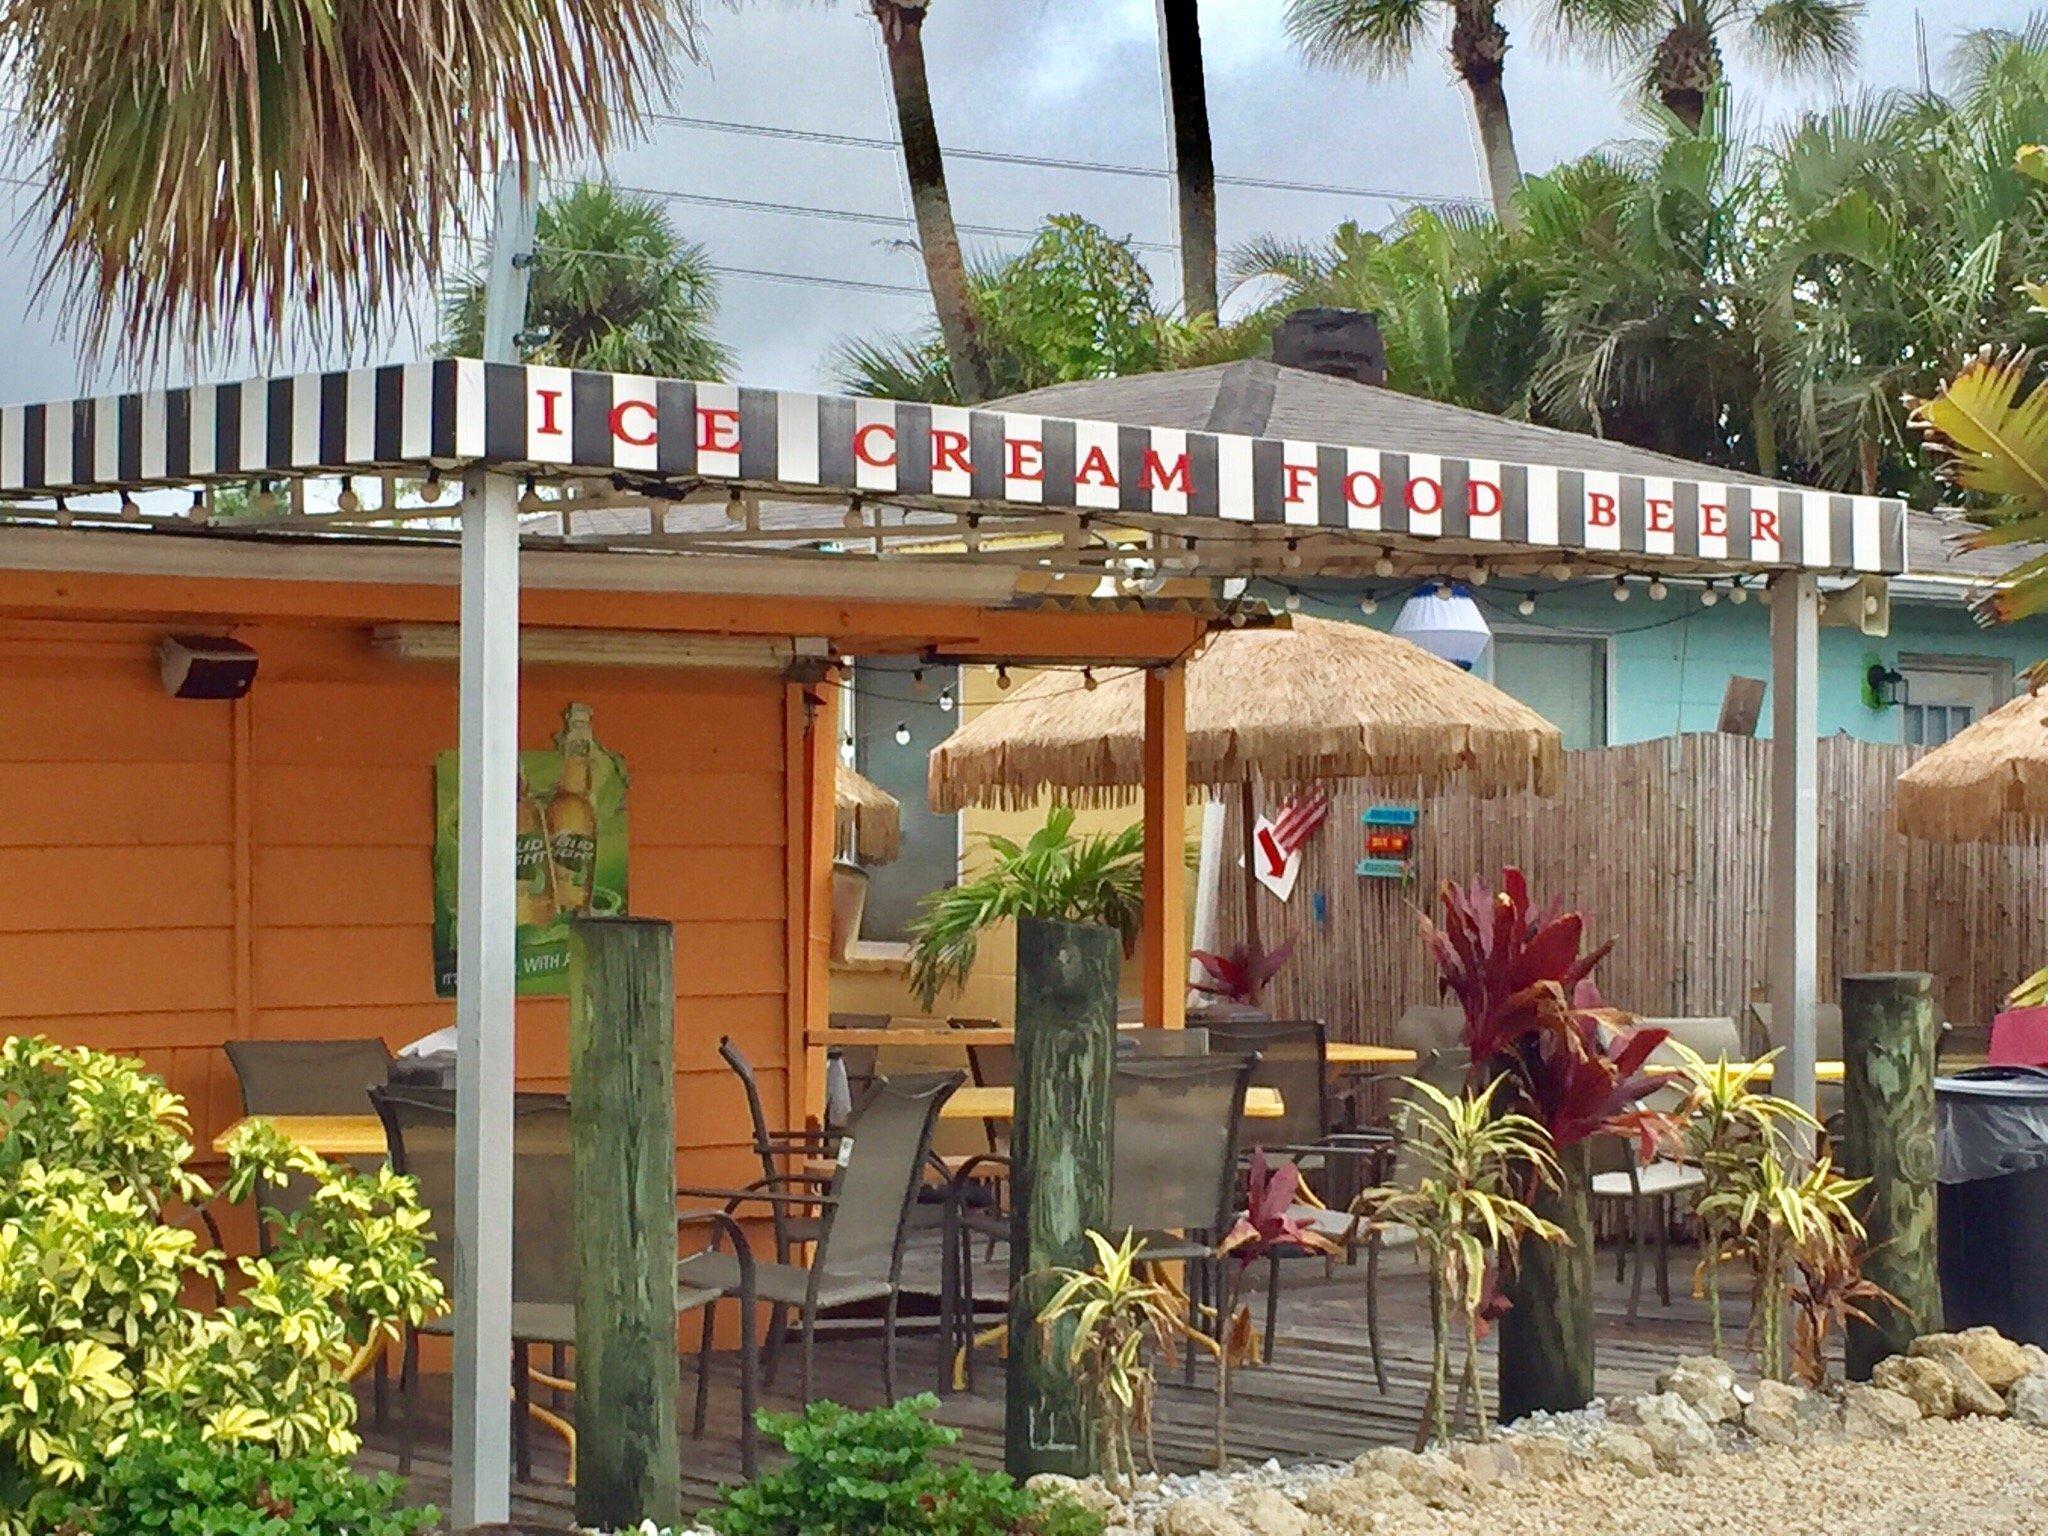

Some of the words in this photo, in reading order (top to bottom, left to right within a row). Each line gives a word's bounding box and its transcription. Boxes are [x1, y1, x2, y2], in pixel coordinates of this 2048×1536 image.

[536, 390, 742, 455] ICE
[851, 424, 1196, 496] CREAM
[1283, 463, 1503, 517] FOOD
[1587, 491, 1782, 542] BEER
[523, 953, 561, 973] WITH
